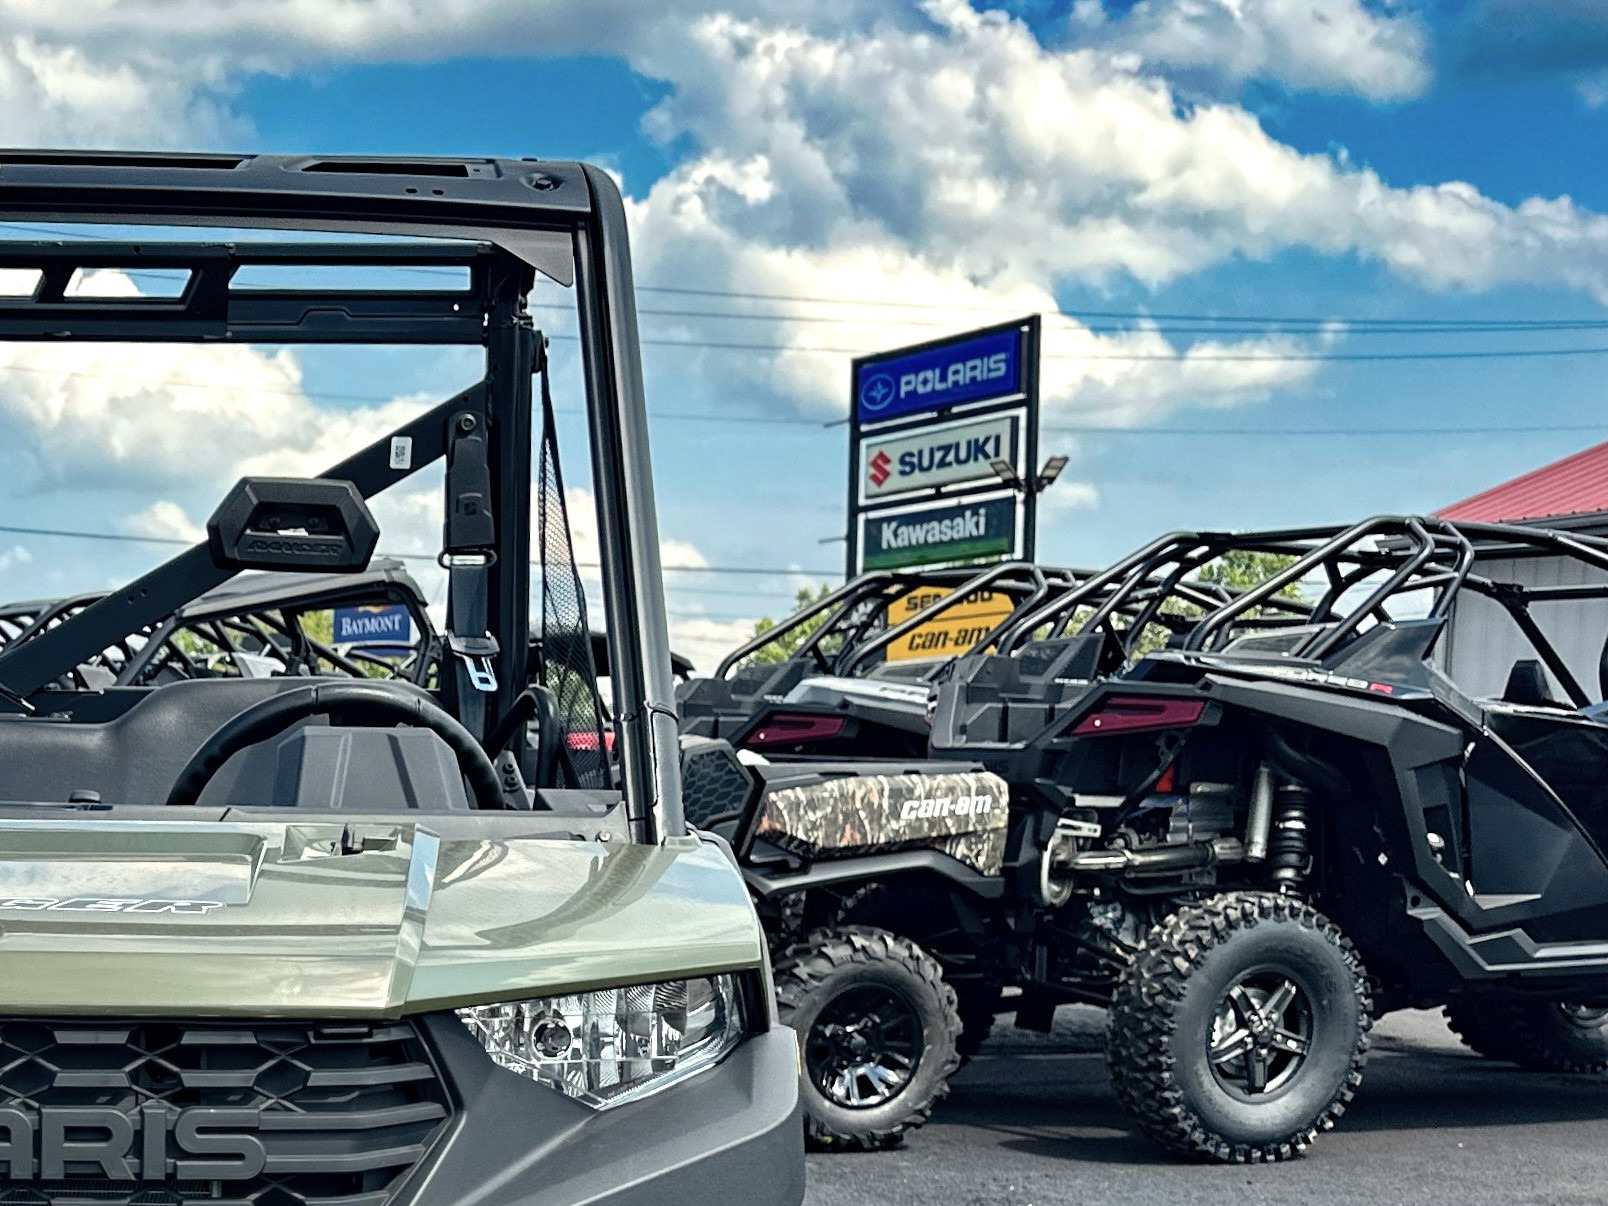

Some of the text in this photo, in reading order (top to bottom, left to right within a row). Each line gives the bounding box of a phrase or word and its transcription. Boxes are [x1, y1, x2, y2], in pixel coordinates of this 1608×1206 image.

[899, 352, 1007, 399] POLARIS
[898, 434, 1001, 476] SUZUKI
[881, 508, 987, 549] Kawasaki
[341, 614, 403, 636] BAYMONT
[900, 794, 992, 820] can-am
